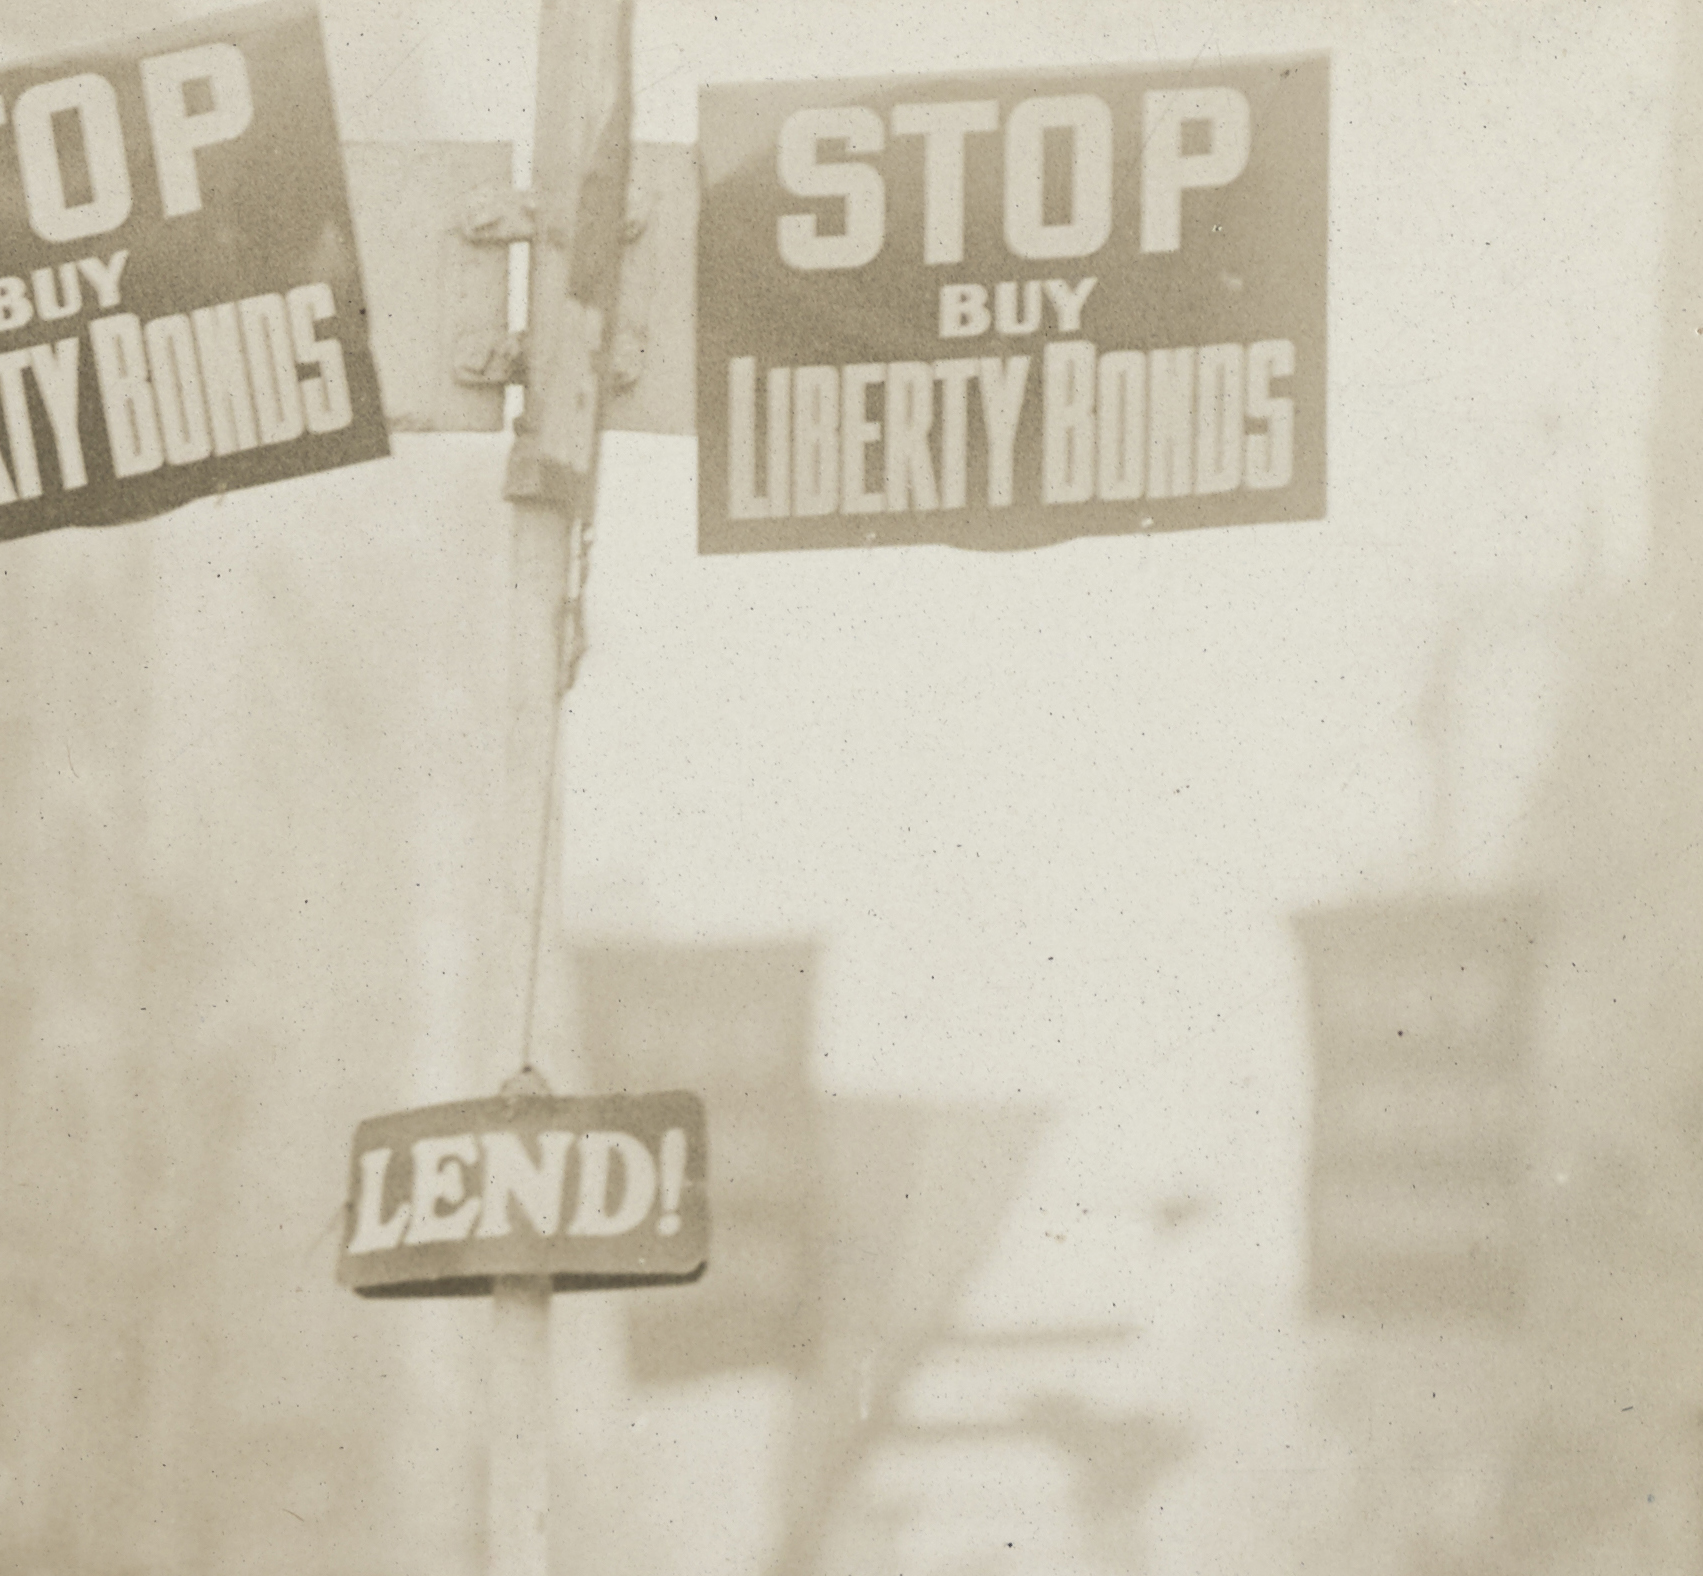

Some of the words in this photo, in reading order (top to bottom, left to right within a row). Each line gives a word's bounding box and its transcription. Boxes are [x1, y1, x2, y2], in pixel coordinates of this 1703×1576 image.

[776, 86, 1252, 271] STOP
[90, 281, 354, 479] BONDS
[938, 276, 1099, 339] BUY
[727, 354, 1031, 521] LIBERTY
[1041, 338, 1296, 505] BONDS
[348, 1127, 687, 1255] LEND!
